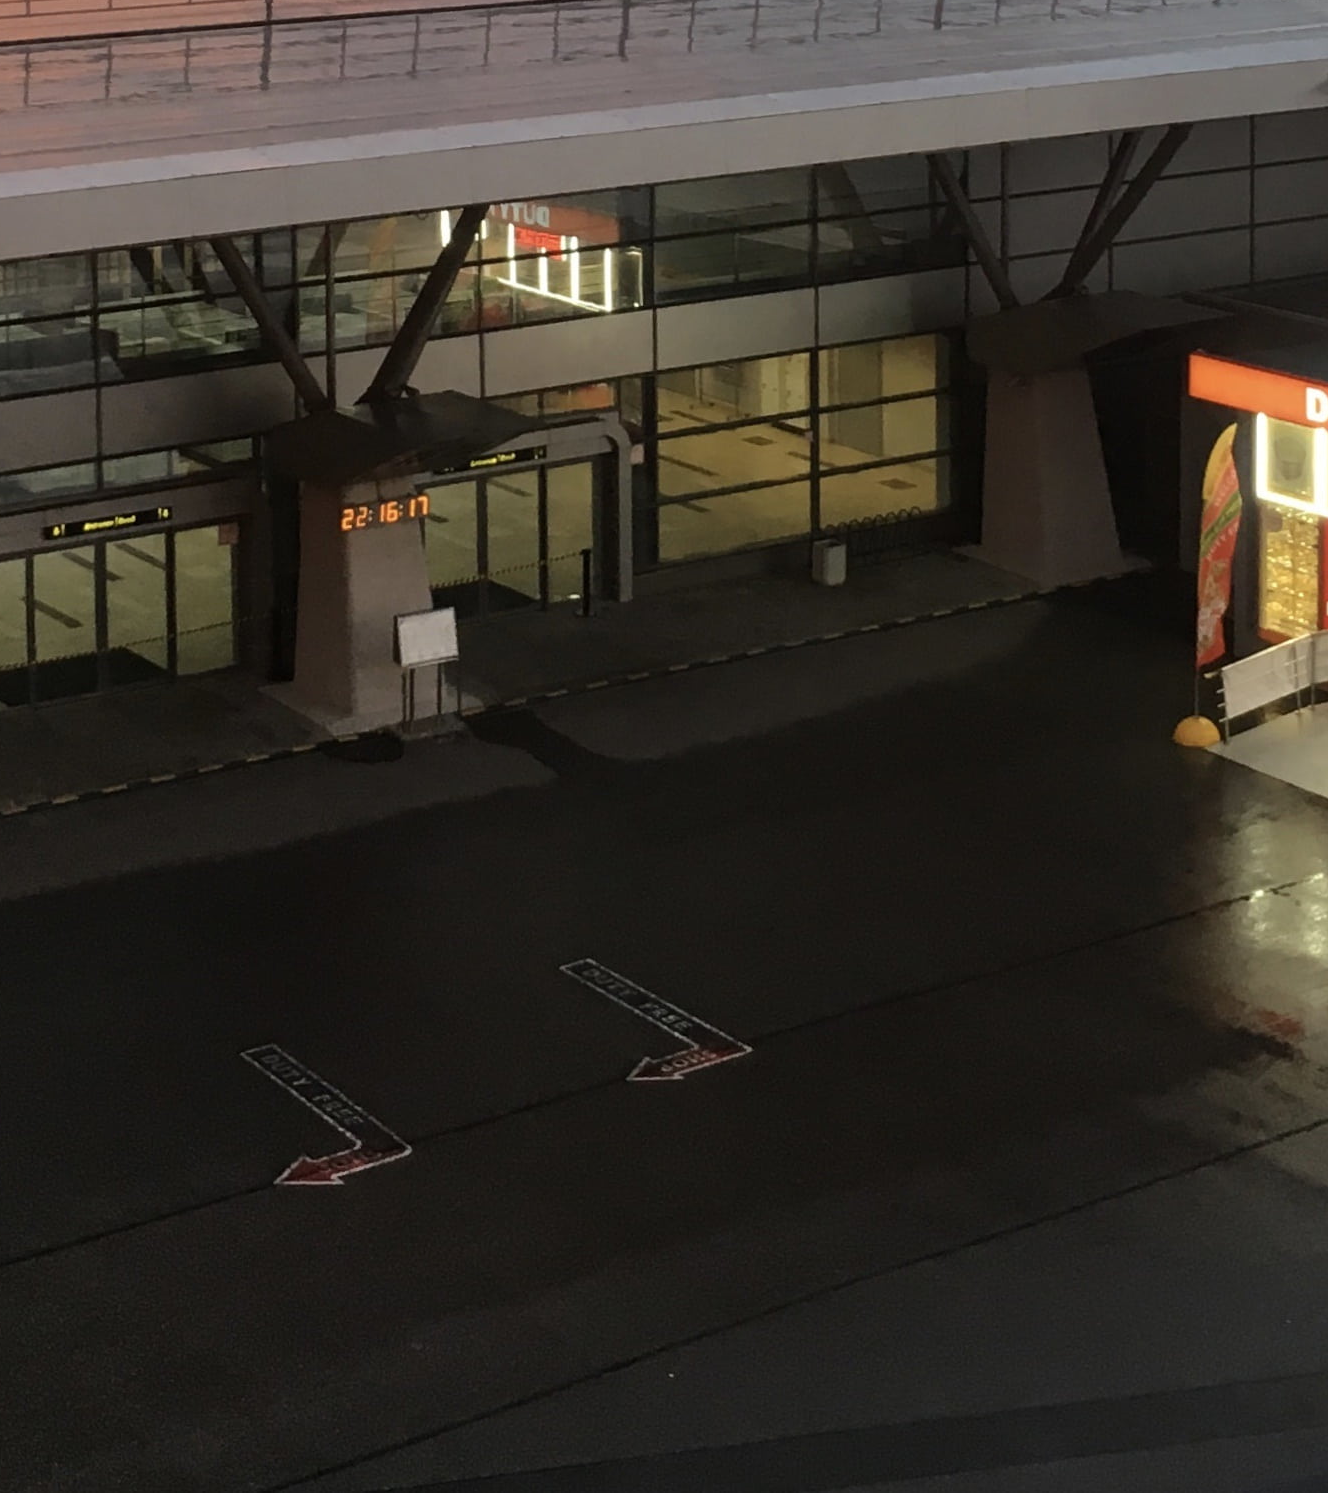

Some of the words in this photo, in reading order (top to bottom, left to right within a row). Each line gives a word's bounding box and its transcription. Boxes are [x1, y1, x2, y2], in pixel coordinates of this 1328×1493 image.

[341, 495, 429, 530] 22:16:17
[582, 968, 637, 997] DUTY
[639, 1002, 693, 1032] FREE
[261, 1053, 313, 1087] DUTY
[311, 1093, 366, 1127] FREE
